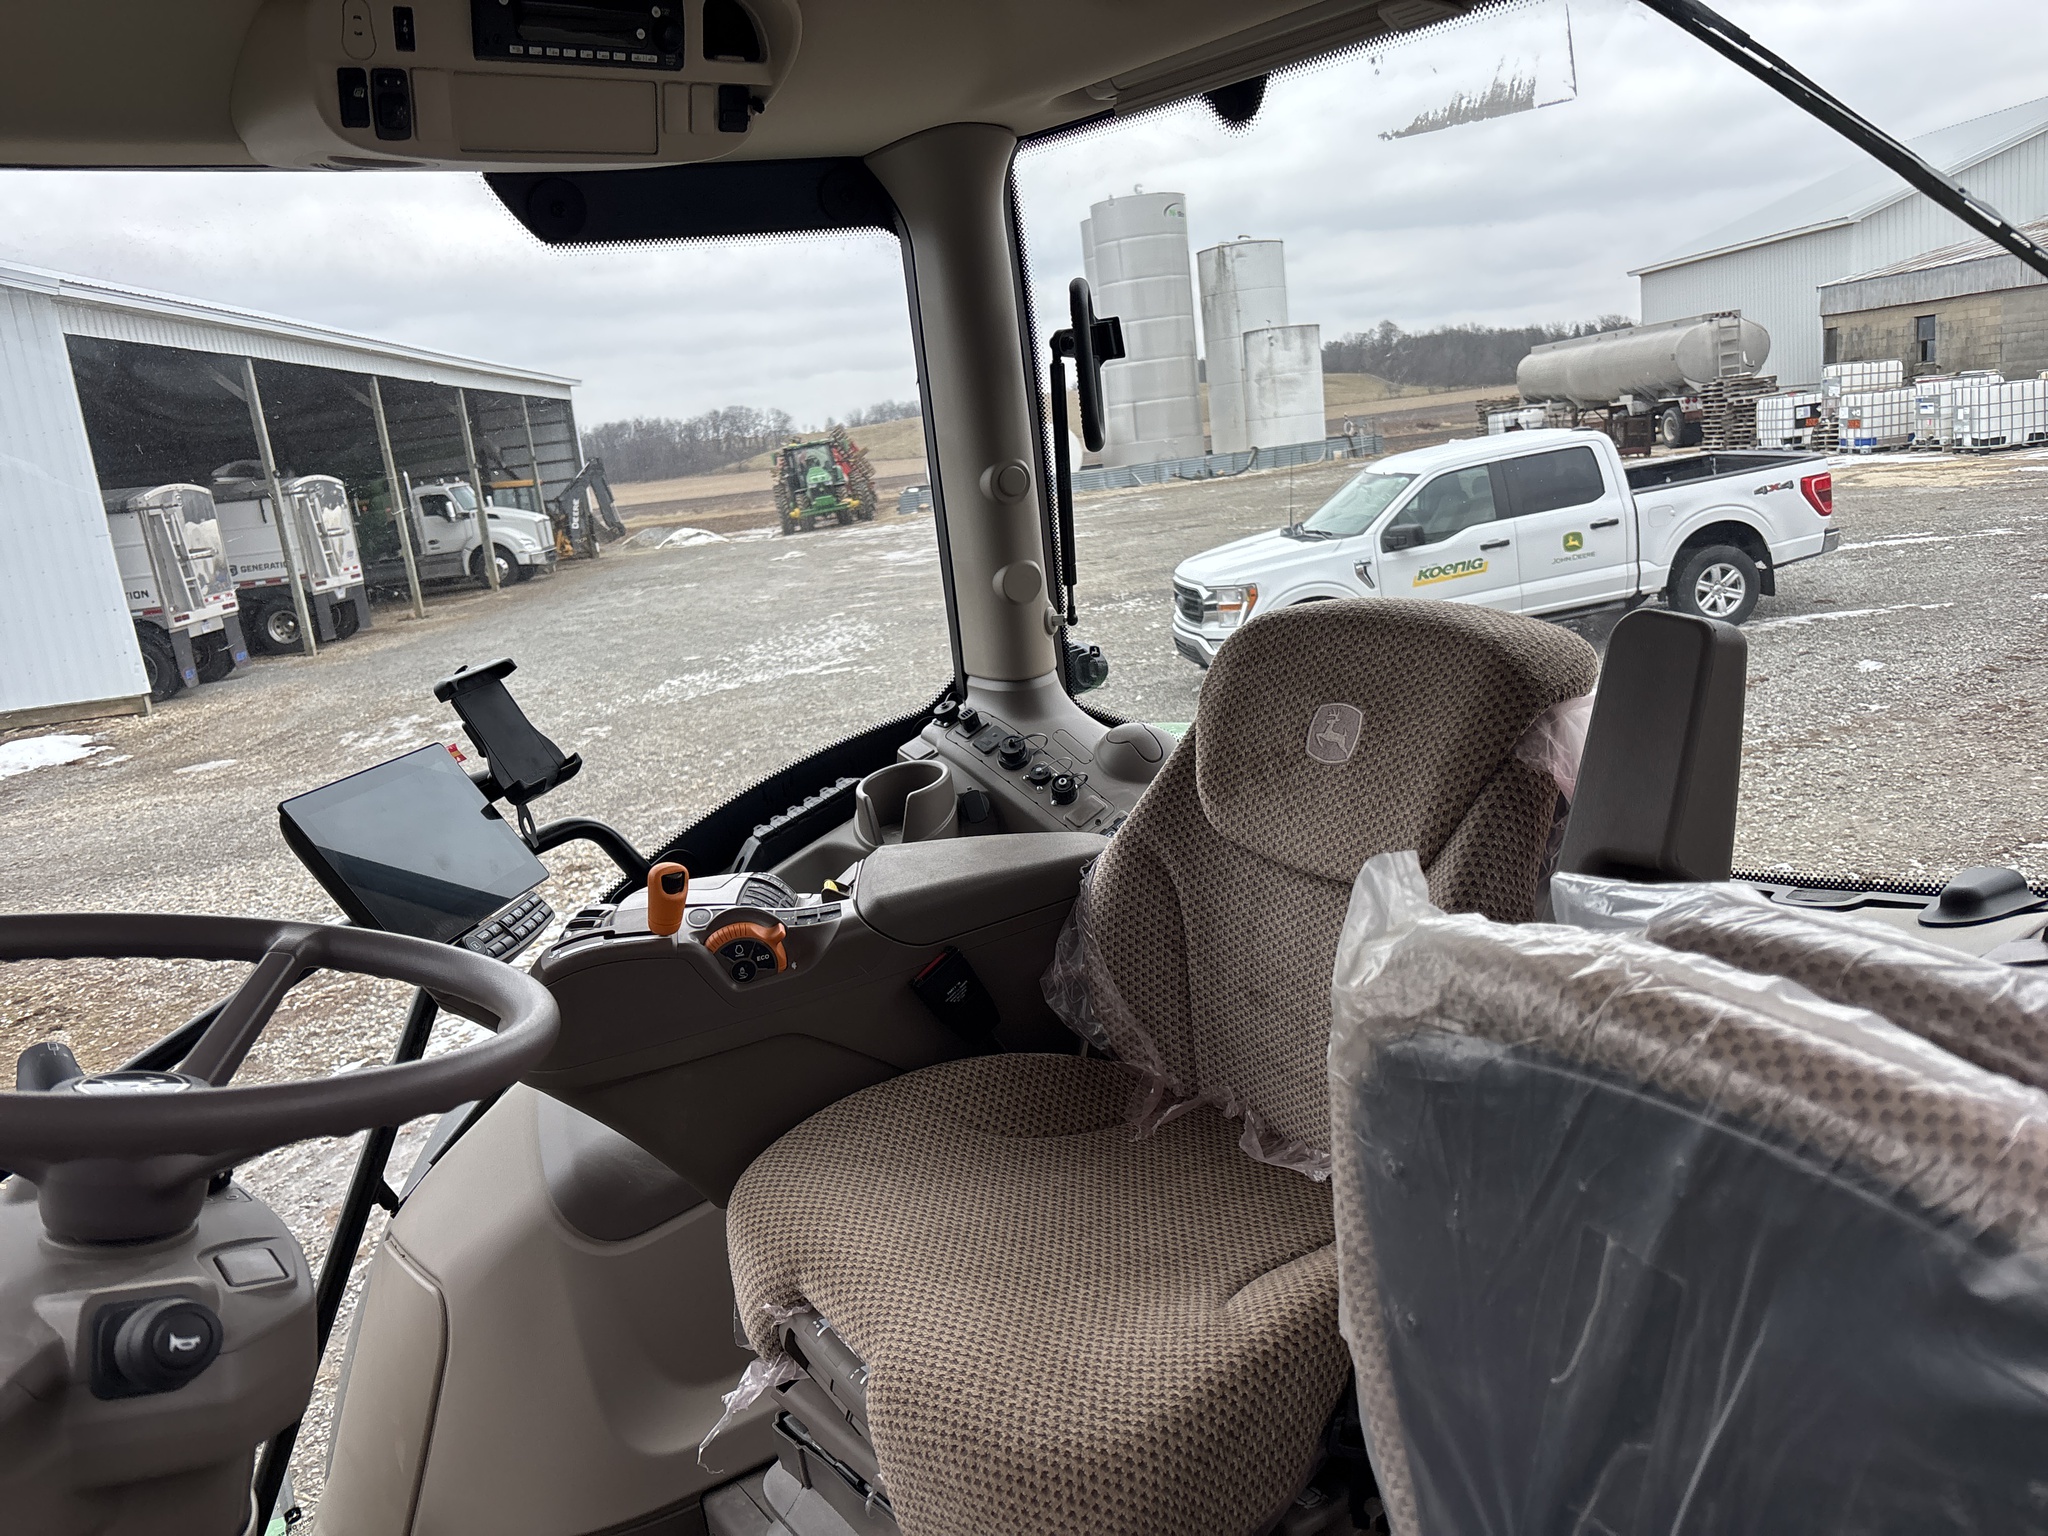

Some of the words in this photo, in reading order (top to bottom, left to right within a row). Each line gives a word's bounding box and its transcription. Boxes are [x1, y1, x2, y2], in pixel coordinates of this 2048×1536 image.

[572, 498, 580, 529] DEERE
[1551, 556, 1571, 565] JOHN
[1572, 551, 1596, 561] DEERE
[757, 954, 770, 962] ECO
